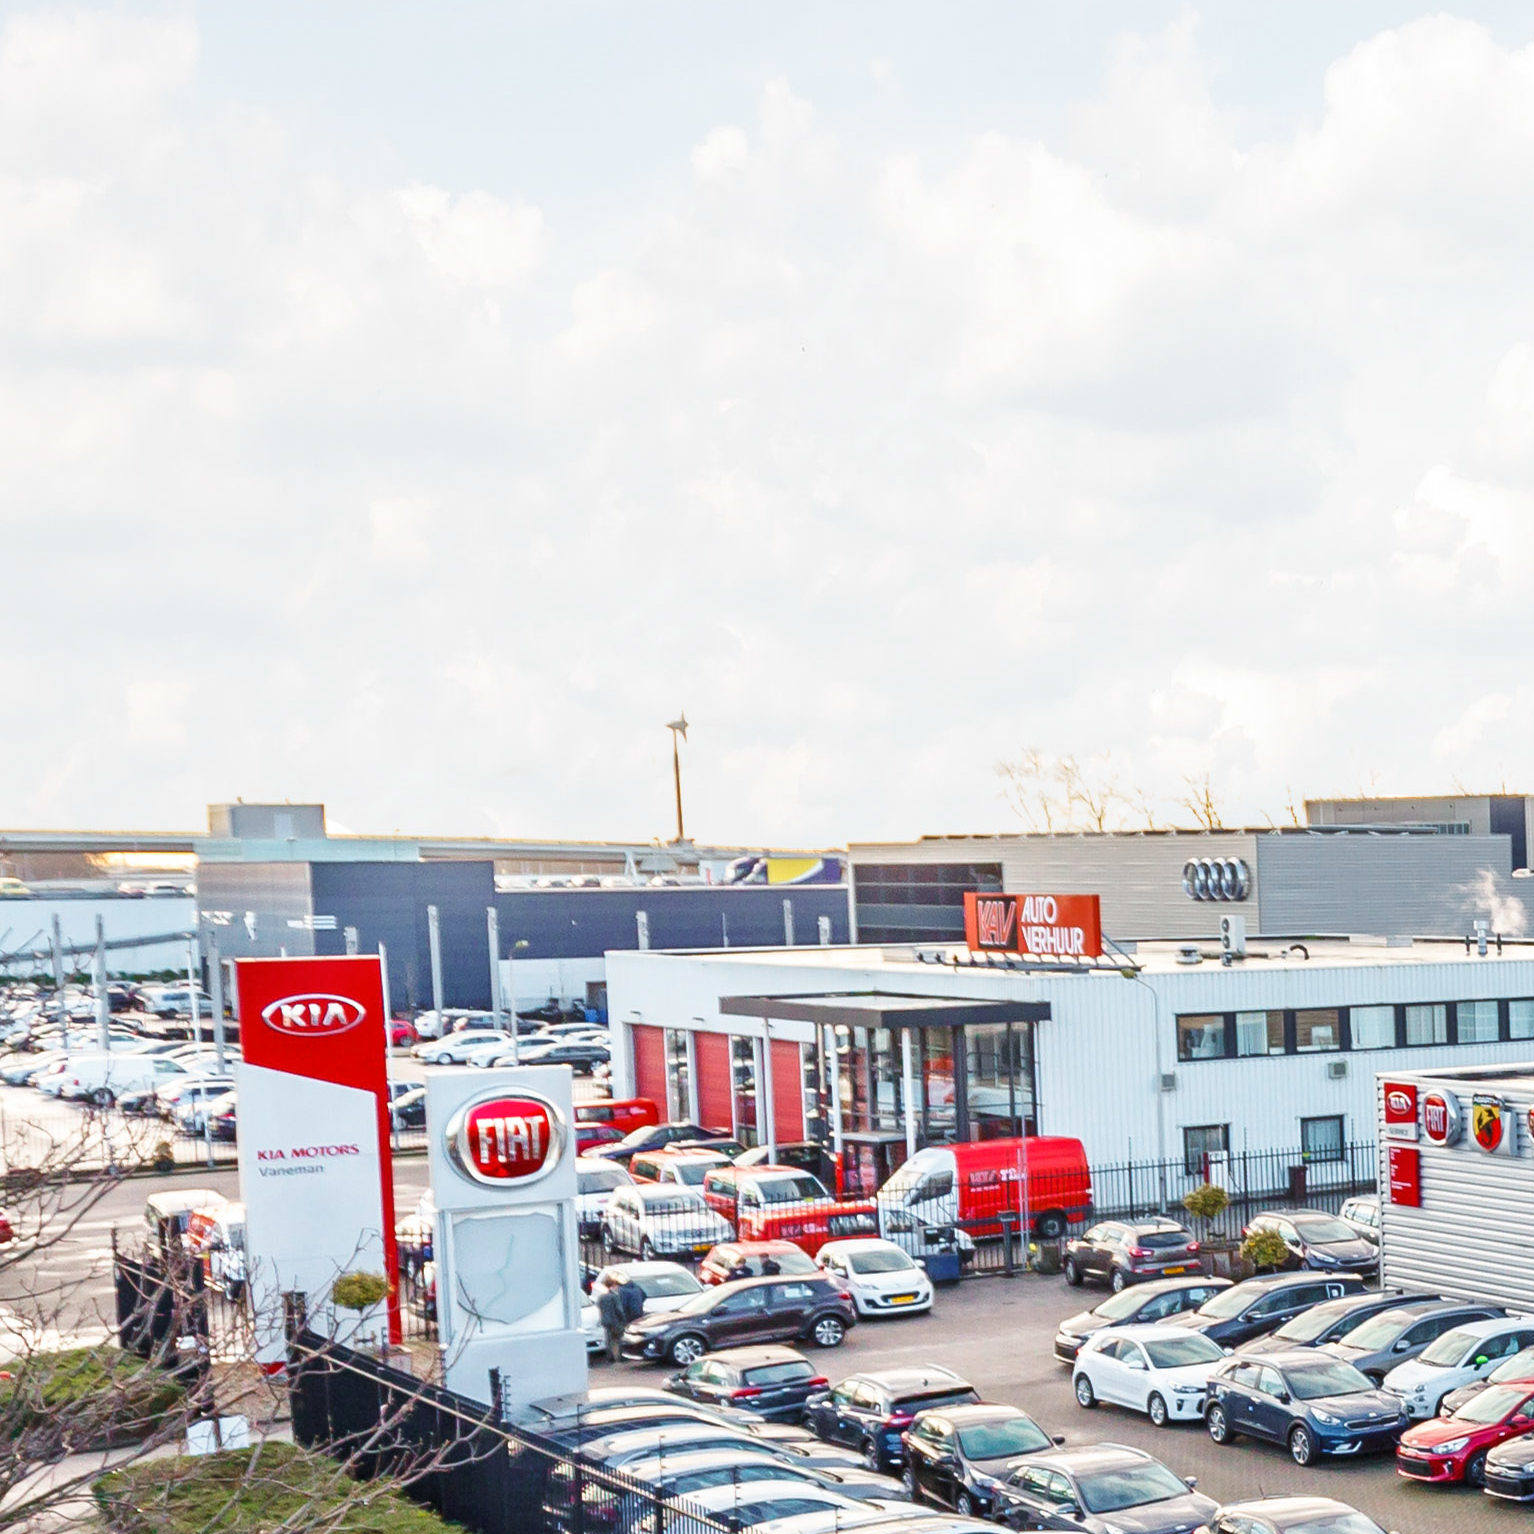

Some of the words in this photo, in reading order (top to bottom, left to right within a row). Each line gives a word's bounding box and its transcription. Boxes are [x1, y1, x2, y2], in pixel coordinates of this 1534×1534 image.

[1021, 895, 1057, 924] AUTO
[1021, 925, 1085, 954] VERHUUR
[280, 1002, 348, 1027] KIA
[1425, 1104, 1446, 1132] FIAT
[257, 1149, 286, 1161] KIA
[290, 1143, 360, 1158] MOTORS
[476, 1115, 546, 1164] FIAT
[258, 1164, 324, 1177] Vaneman
